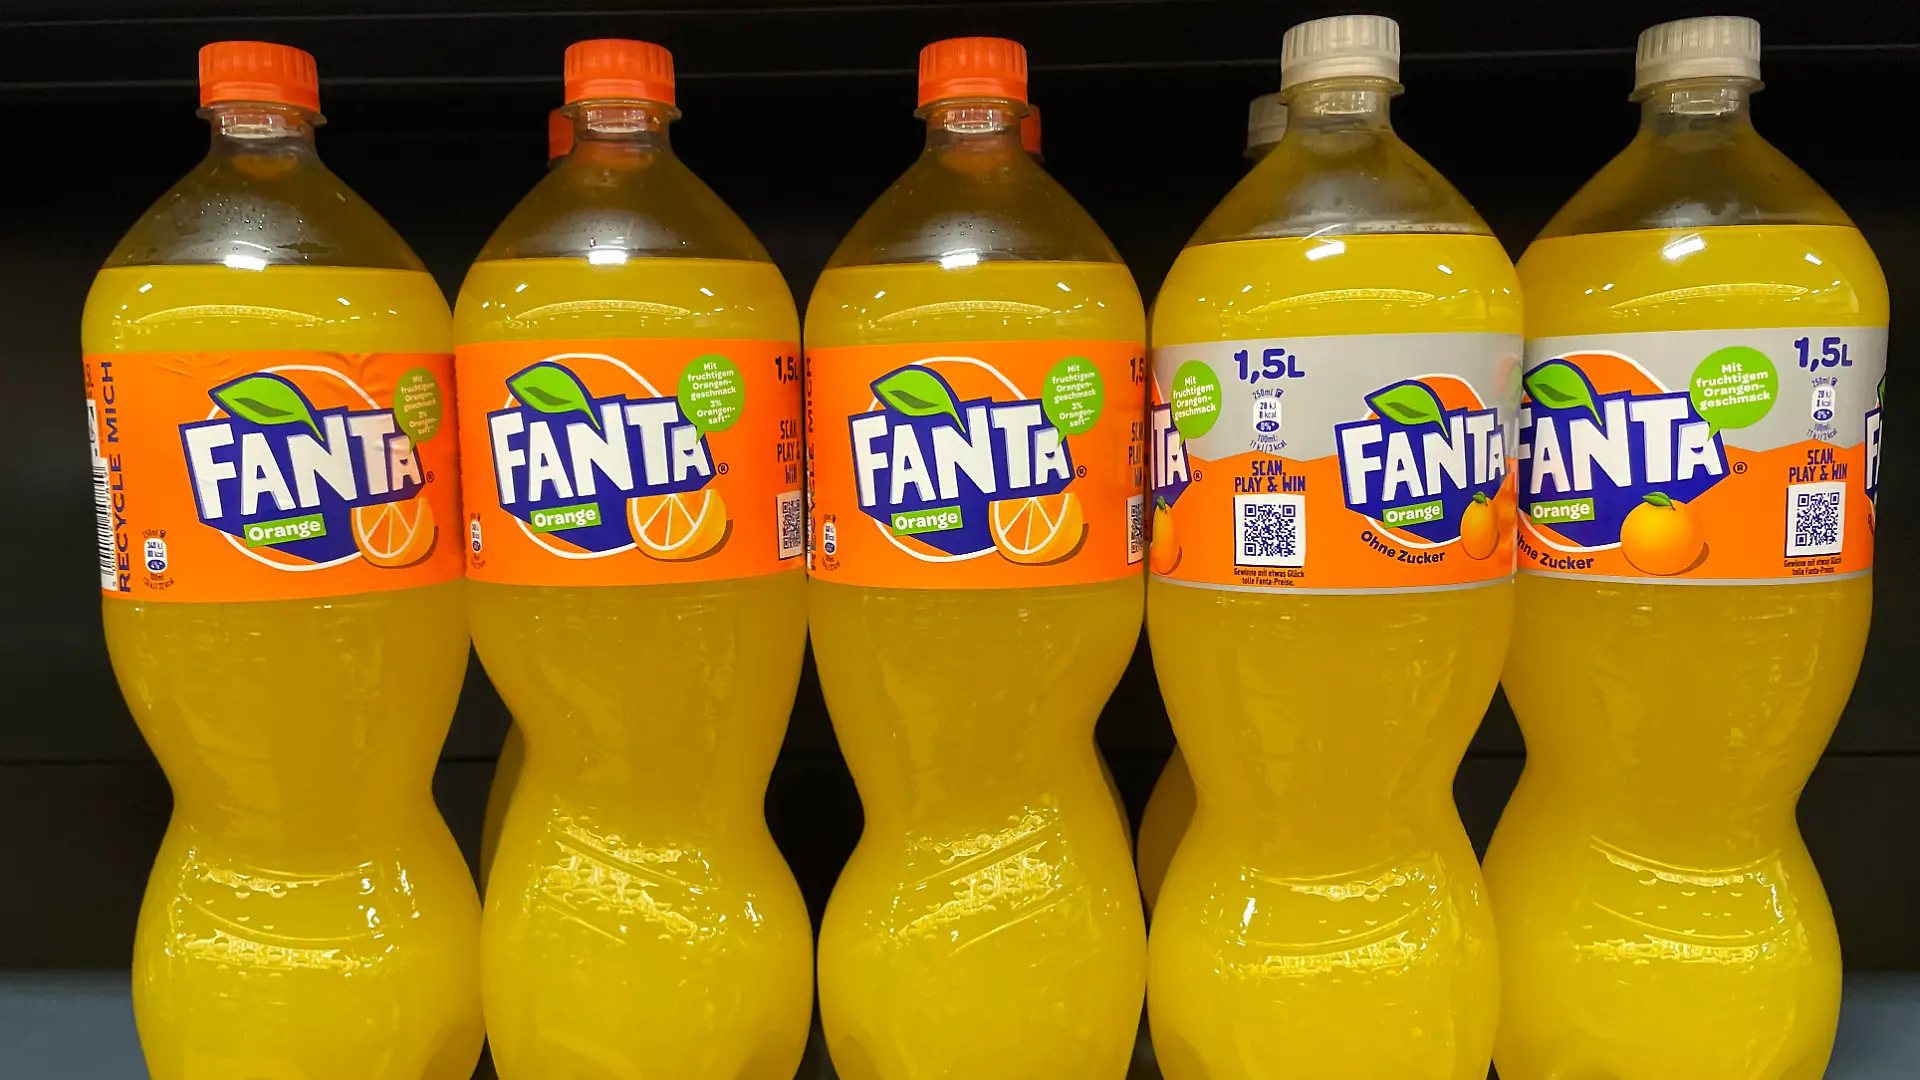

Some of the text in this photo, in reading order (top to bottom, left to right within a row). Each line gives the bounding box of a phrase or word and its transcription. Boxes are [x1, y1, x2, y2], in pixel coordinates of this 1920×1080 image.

[1793, 336, 1853, 373] 1,5L
[703, 362, 717, 371] Mit
[1067, 365, 1080, 373] Mit
[1233, 348, 1306, 384] 1,5L
[1721, 362, 1743, 373] Mit
[687, 369, 735, 382] fruchtigem
[1052, 372, 1095, 384] fruchtigem
[1184, 376, 1197, 386] Mit
[1695, 371, 1769, 388] fruchtigem
[692, 379, 732, 391] Orangen-
[1056, 382, 1093, 393] Orangen-
[1172, 383, 1215, 399] fruchtigem
[1703, 383, 1766, 397] Orangen-
[690, 386, 737, 401] geschmack
[1054, 388, 1096, 404] geschmack
[1176, 394, 1212, 408] Orangen-
[1252, 388, 1274, 400] 250ml
[1699, 390, 1771, 411] geschmack
[709, 399, 722, 408] 3%
[1071, 402, 1083, 410] 3%
[696, 406, 736, 418] Orangen-
[1059, 409, 1095, 421] Orangen-
[1174, 403, 1217, 421] geschmack
[1264, 410, 1277, 419] kcal
[490, 402, 712, 505] FANTA
[851, 404, 1072, 507] FANTA
[1340, 413, 1506, 505] FANTA
[1807, 448, 1836, 466] SCAN,
[185, 412, 423, 520] FANTA
[1251, 459, 1287, 477] SCAN,
[1788, 463, 1848, 483] PLAY & WIN
[100, 361, 131, 593] RECYCLE MICH
[1234, 475, 1306, 493] PLAY & WIN
[533, 507, 597, 529] Orange
[1385, 505, 1441, 523] Orange
[1533, 503, 1591, 520] Orange
[894, 509, 959, 531] Orange
[248, 519, 322, 541] Orange
[1360, 530, 1446, 565] Ohne Zucker
[1539, 552, 1595, 570] Zucker
[1233, 567, 1305, 578] Gewinne mit etwas Glück
[1241, 576, 1255, 585] tolle
